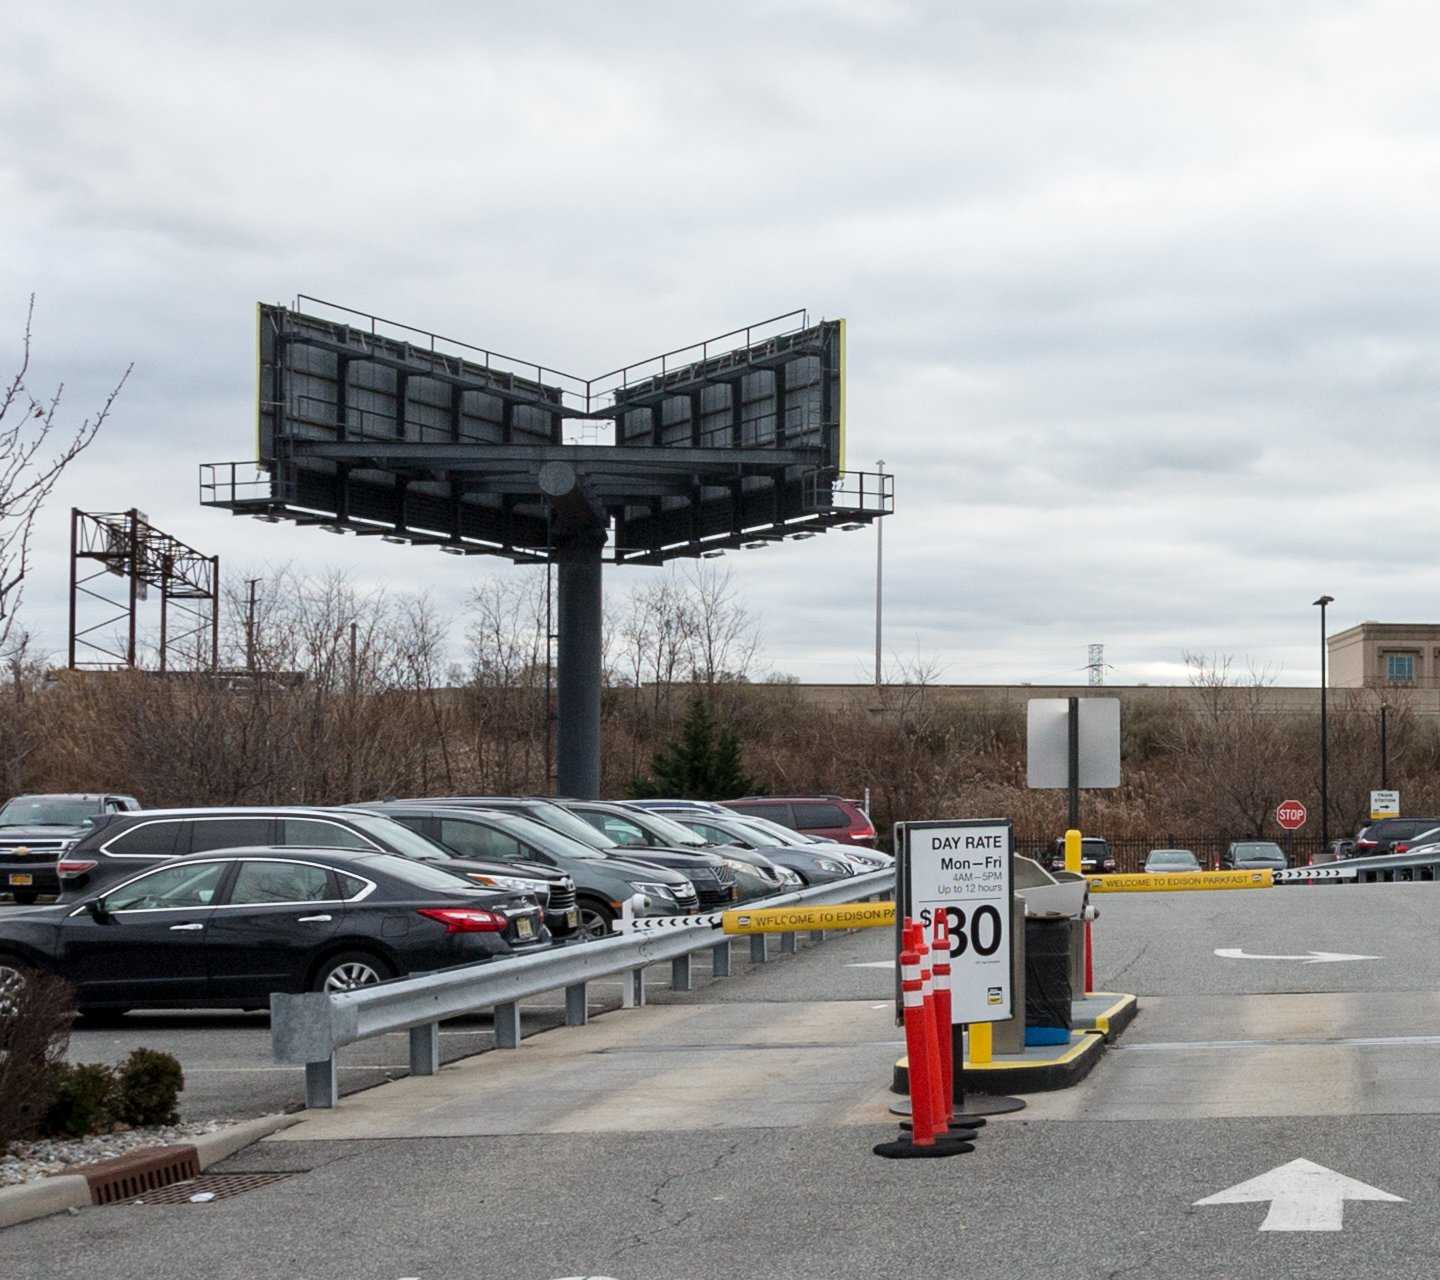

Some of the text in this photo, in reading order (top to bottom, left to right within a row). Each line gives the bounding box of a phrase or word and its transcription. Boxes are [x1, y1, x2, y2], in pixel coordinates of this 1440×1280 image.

[1279, 809, 1304, 821] STOP
[931, 836, 1002, 850] DAY RATE
[938, 882, 1002, 895] Up to 12 hours
[1106, 879, 1150, 888] WELCOME
[1153, 878, 1166, 886] TO
[1167, 877, 1201, 886] EDISON
[1203, 876, 1248, 885] PARKFAST
[819, 913, 834, 922] TO
[836, 909, 881, 921] EDISON
